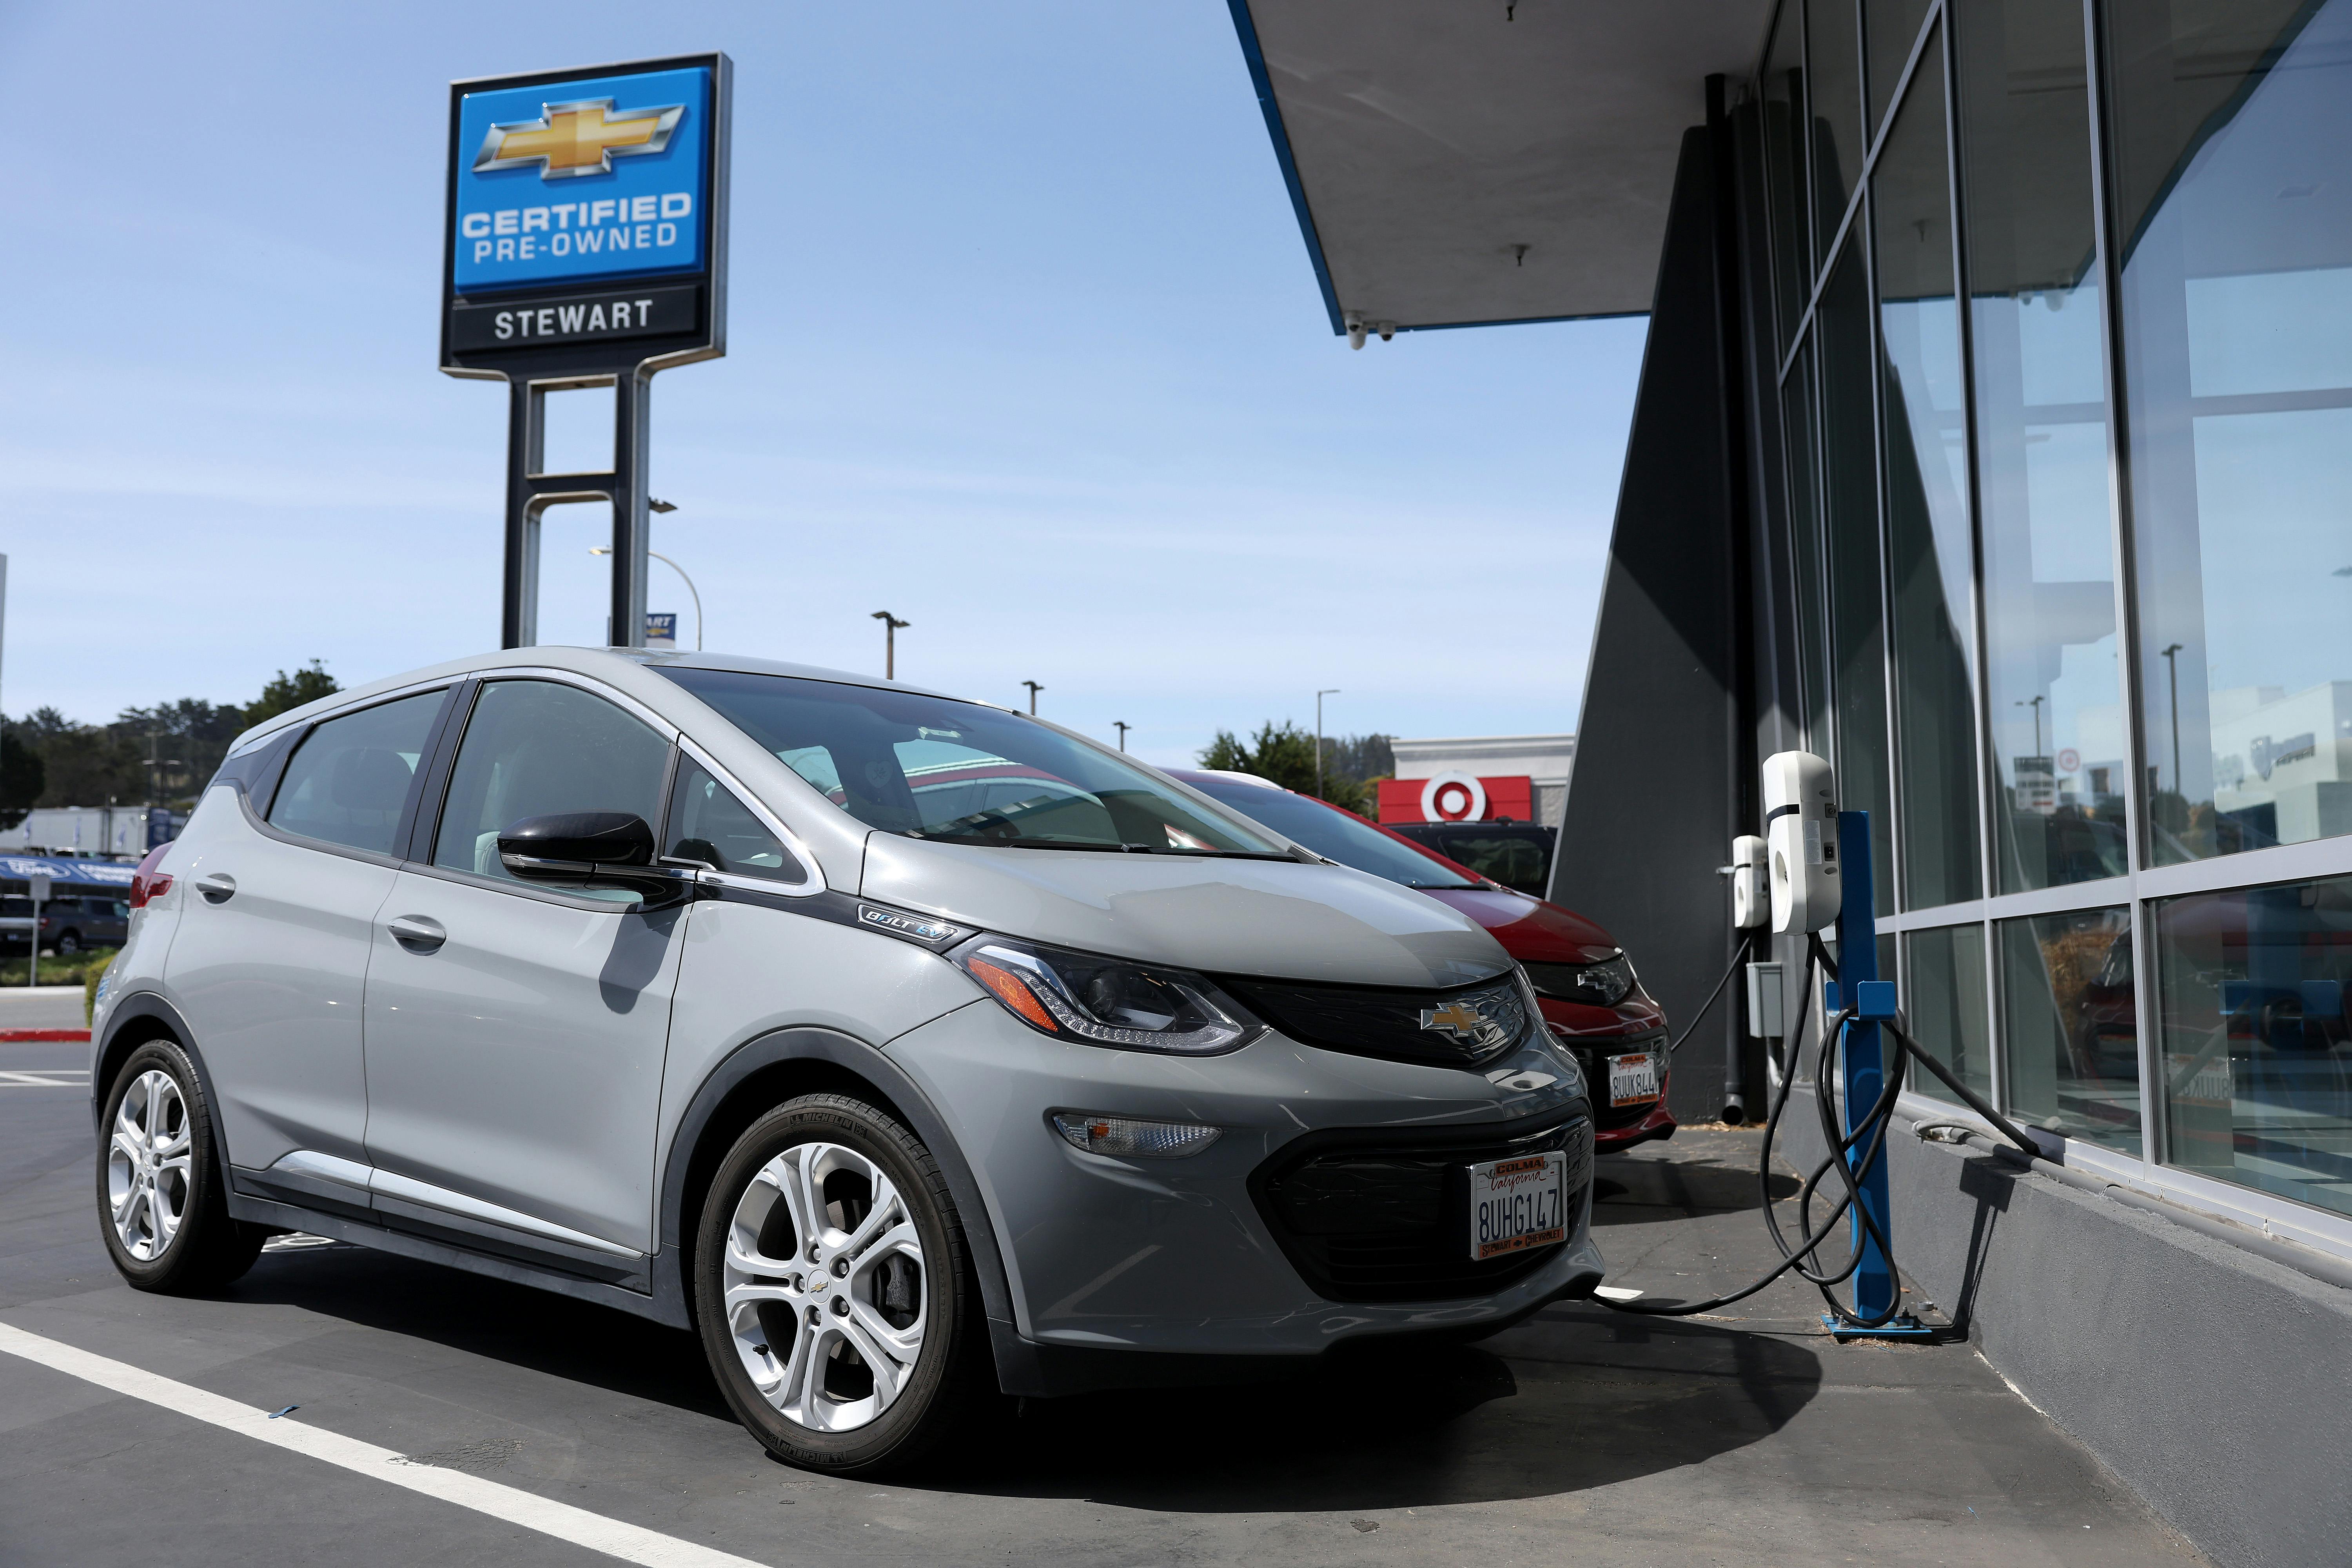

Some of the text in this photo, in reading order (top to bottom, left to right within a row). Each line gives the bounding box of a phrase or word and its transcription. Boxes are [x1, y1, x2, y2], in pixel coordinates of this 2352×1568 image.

[462, 192, 692, 239] CERTIFIED
[474, 223, 677, 263] PRE-OWNED
[494, 299, 653, 340] STEWART
[865, 911, 946, 937] BOLT EV
[1613, 1072, 1655, 1099] 8UUK844
[802, 1112, 853, 1129] MICHELIN
[1496, 1159, 1542, 1174] COLMA
[1490, 1171, 1547, 1194] California
[1479, 1189, 1557, 1243] 8UHG147
[1482, 1229, 1561, 1257] STEWART CHEVROLET
[701, 1273, 710, 1327] ENERGY
[780, 1442, 830, 1463] MICHELIN
